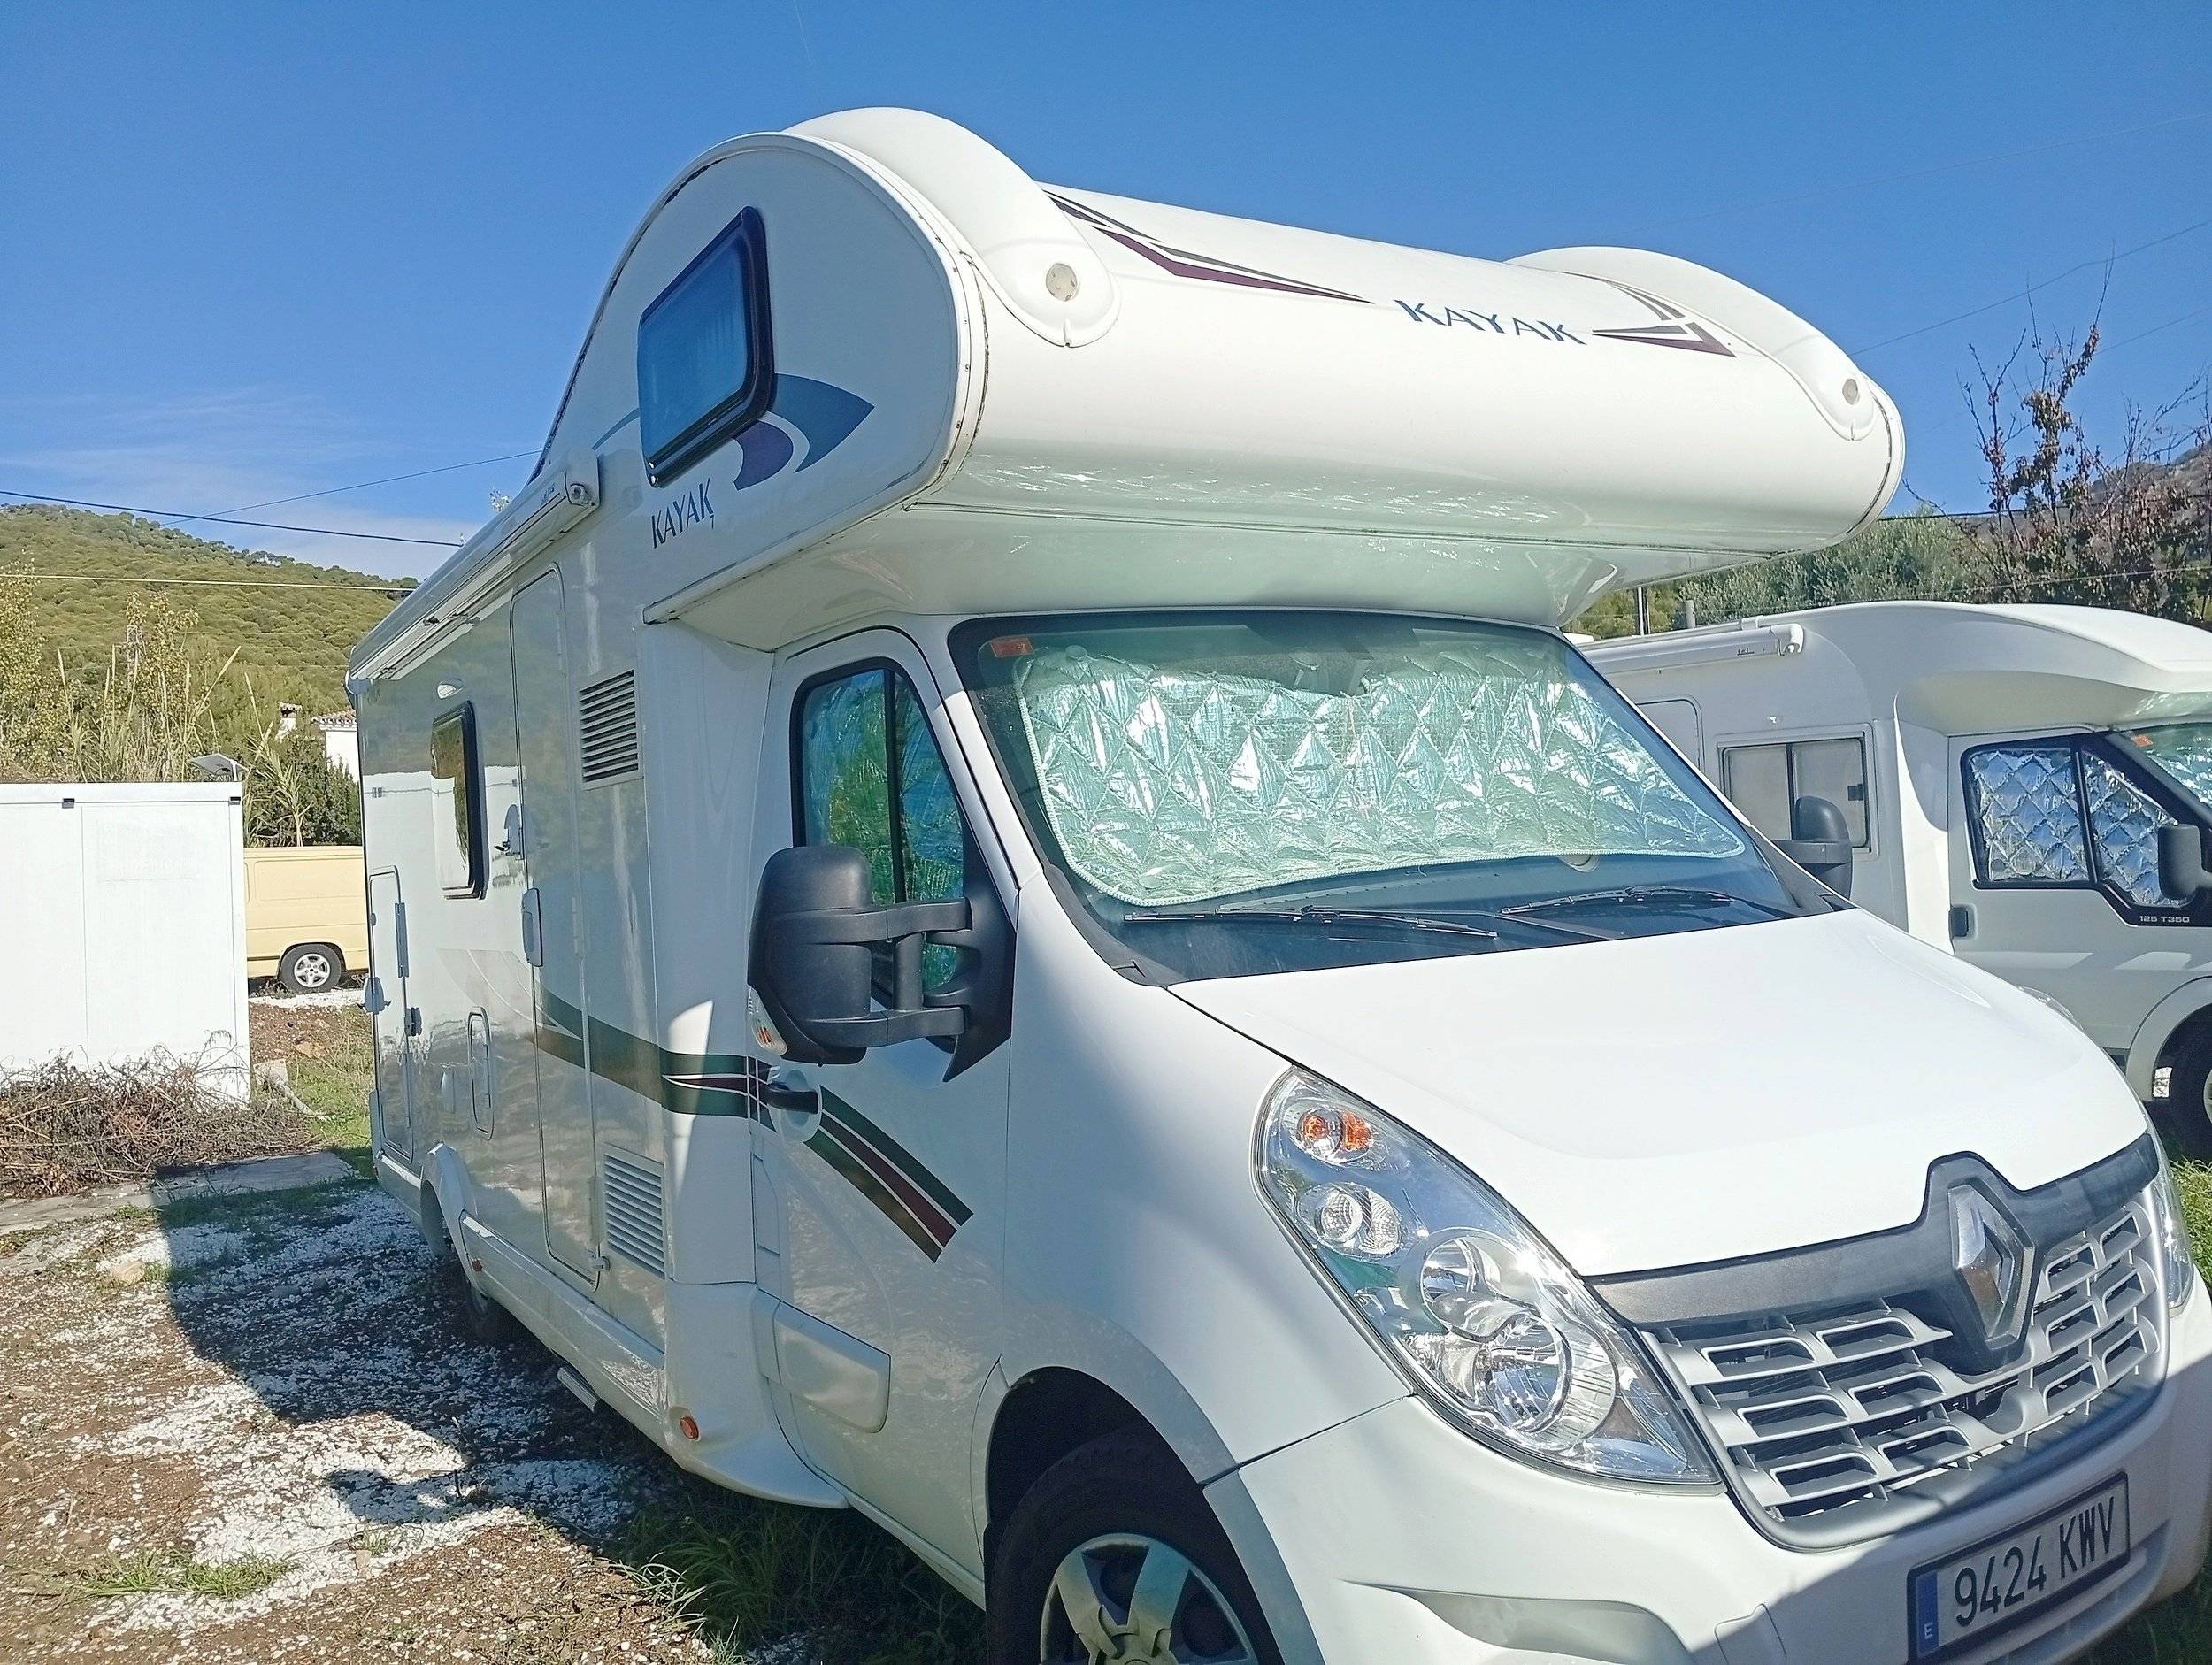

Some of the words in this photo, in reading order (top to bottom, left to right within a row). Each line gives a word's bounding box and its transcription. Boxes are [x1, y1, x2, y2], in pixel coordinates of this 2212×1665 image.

[1394, 299, 1587, 345] KAYAK
[651, 478, 715, 549] KAYAK
[1954, 1535, 2047, 1627] 9424
[2059, 1496, 2114, 1579] KWV
[1924, 1622, 1934, 1640] E
